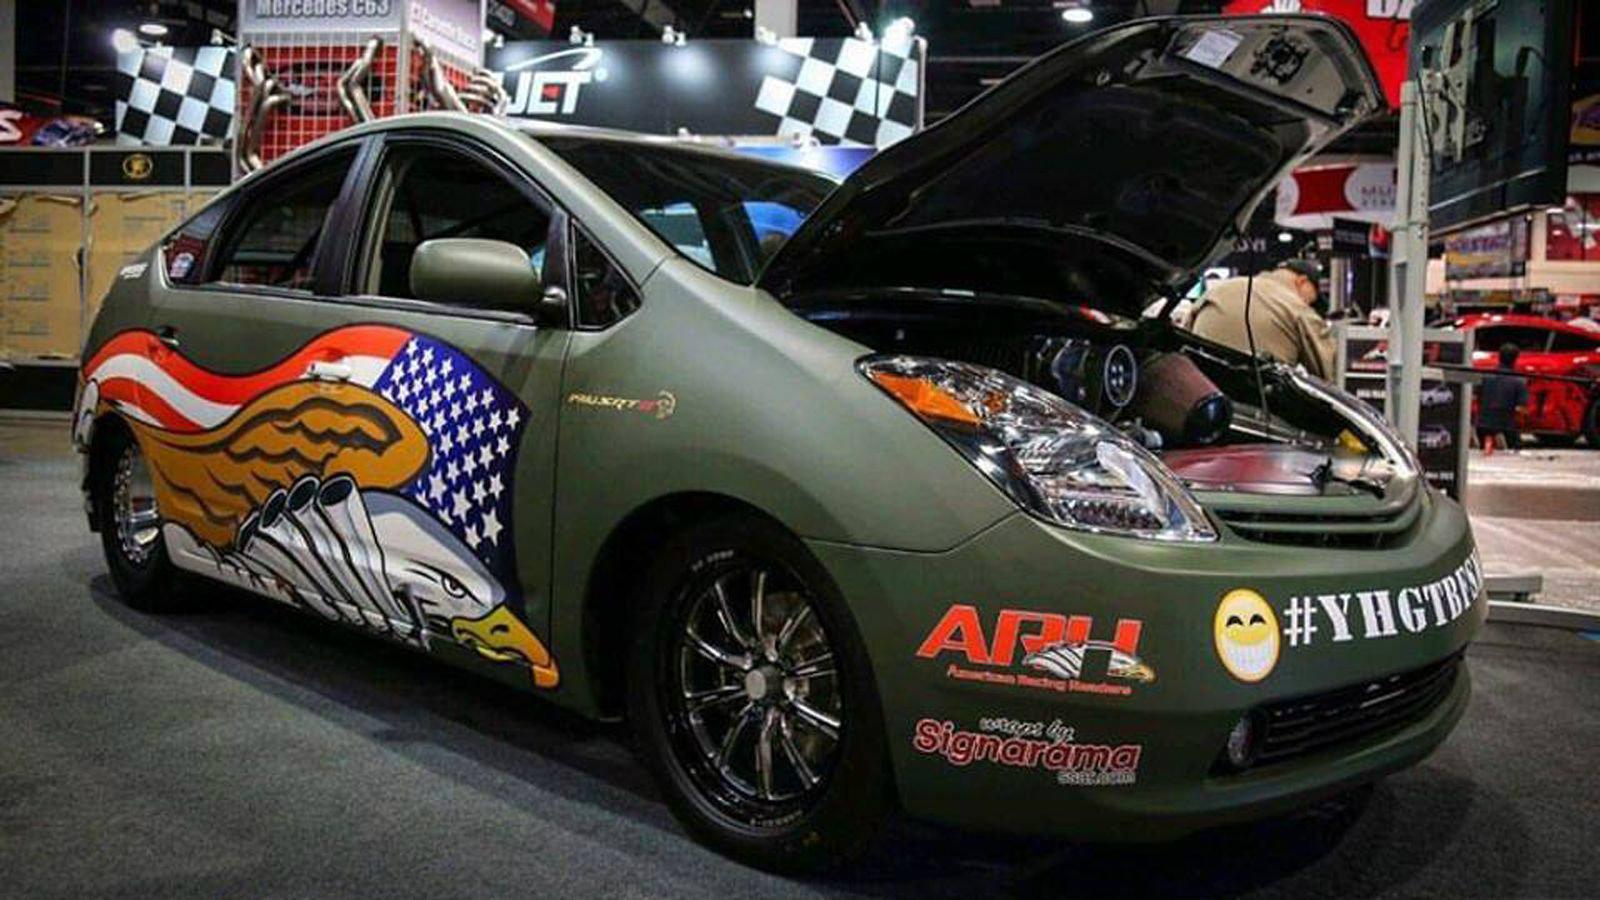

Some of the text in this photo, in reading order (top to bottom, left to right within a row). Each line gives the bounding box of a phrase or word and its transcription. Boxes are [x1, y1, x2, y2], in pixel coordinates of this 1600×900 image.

[256, 0, 390, 16] Mercedes C63
[494, 71, 592, 115] JET
[947, 663, 1133, 696] American Racing Headers
[913, 718, 1142, 773] Signarama
